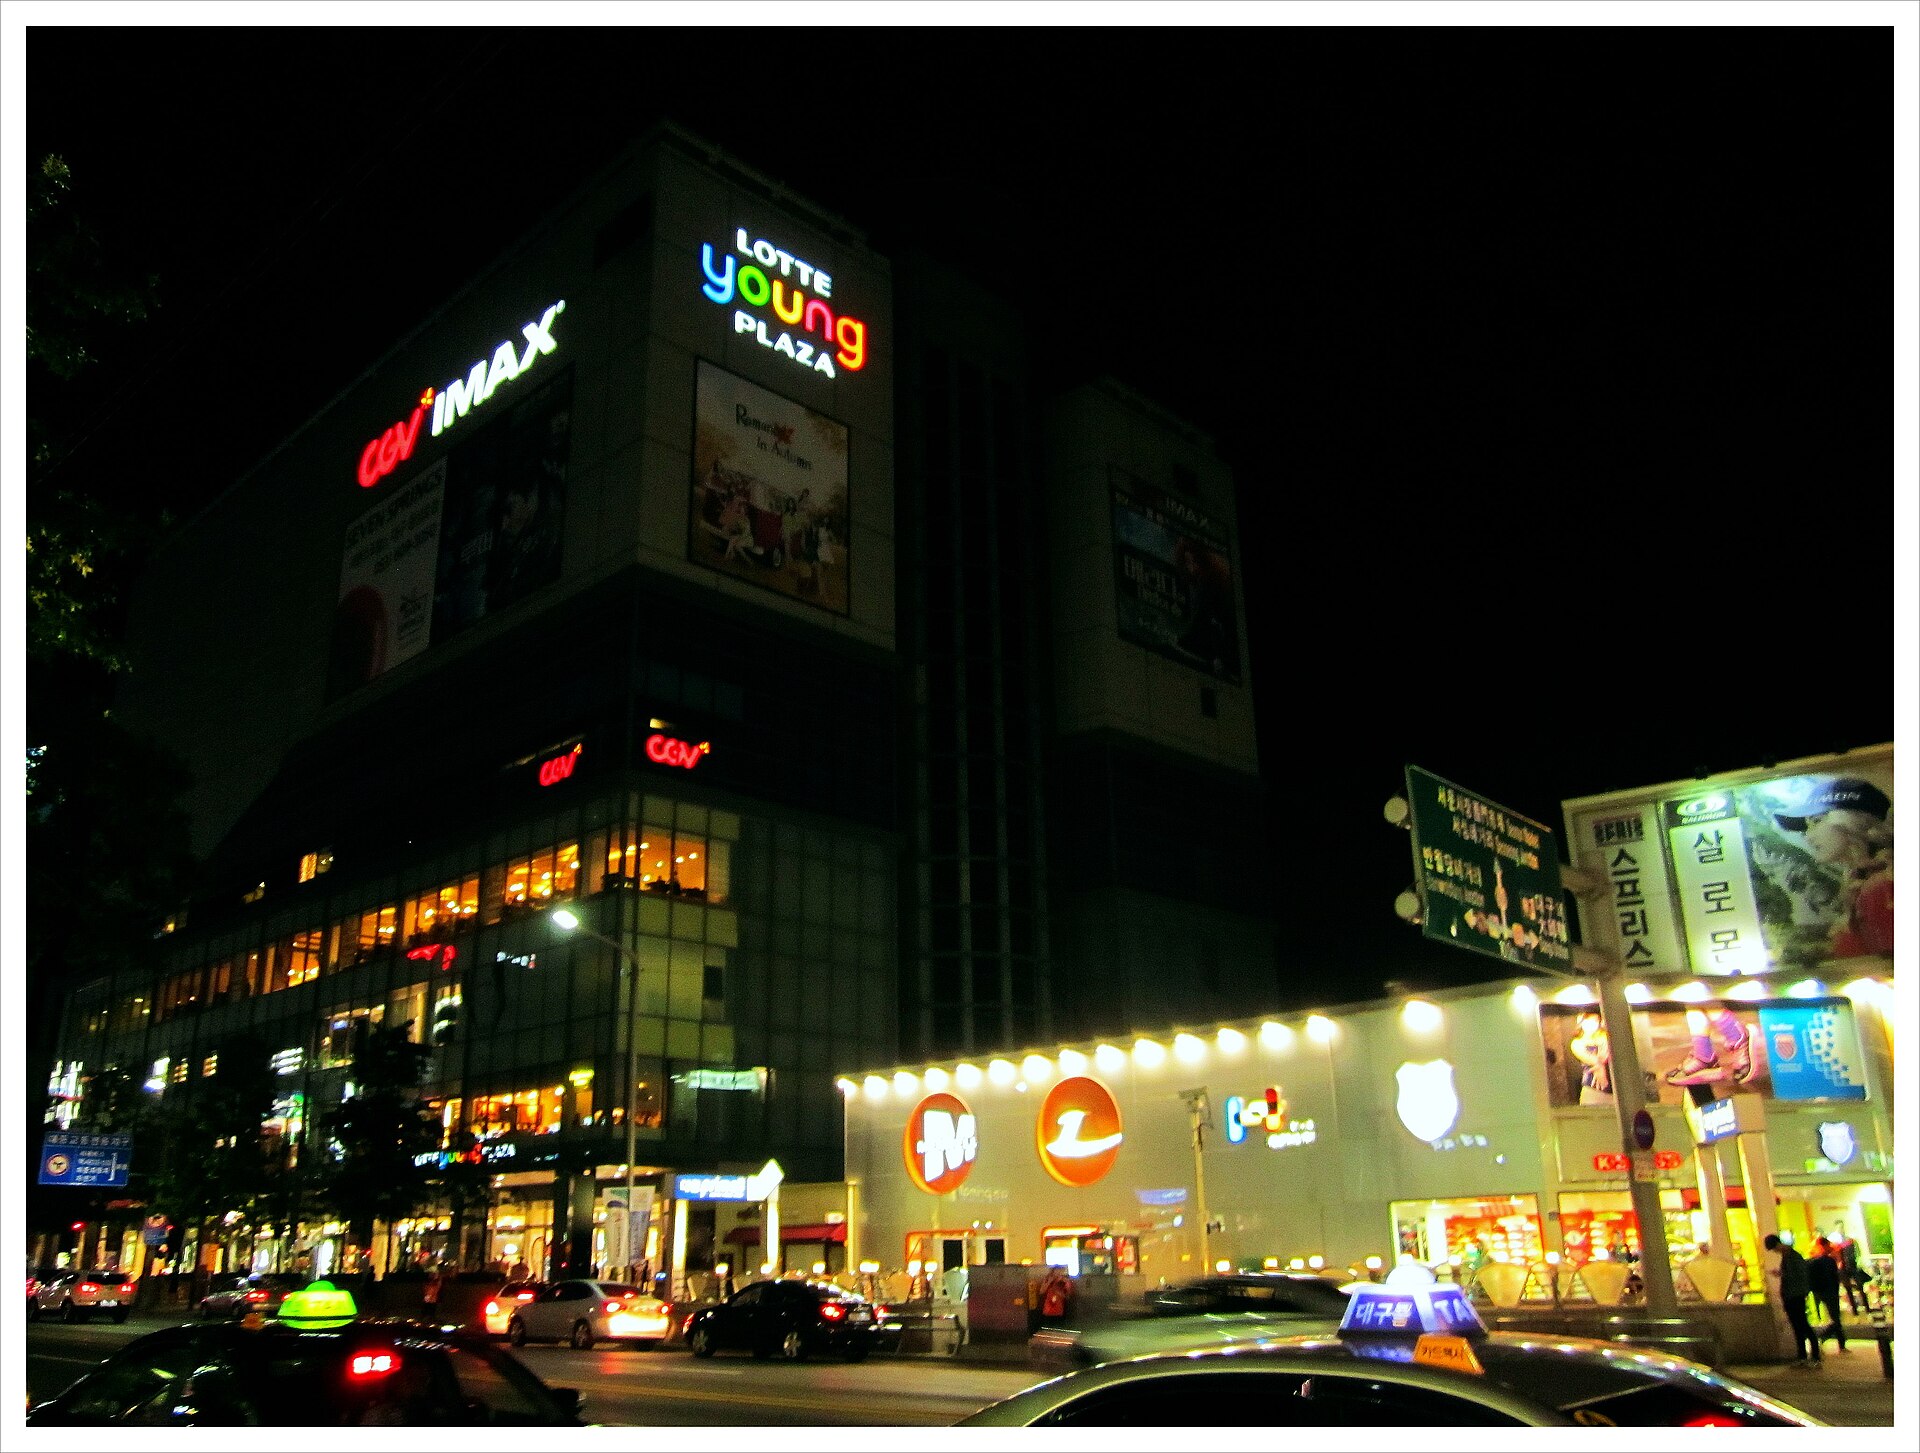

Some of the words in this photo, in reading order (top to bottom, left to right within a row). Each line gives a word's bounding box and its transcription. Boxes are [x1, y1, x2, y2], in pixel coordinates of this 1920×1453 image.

[702, 242, 868, 371] young
[736, 227, 833, 298] LOTTE
[733, 310, 836, 379] PLAZA
[357, 405, 425, 488] CGV
[431, 302, 559, 437] IMAX
[540, 752, 577, 786] CGV
[646, 734, 701, 770] CGV
[1610, 848, 1655, 968] 스프리스
[1693, 830, 1742, 964] 살로몬
